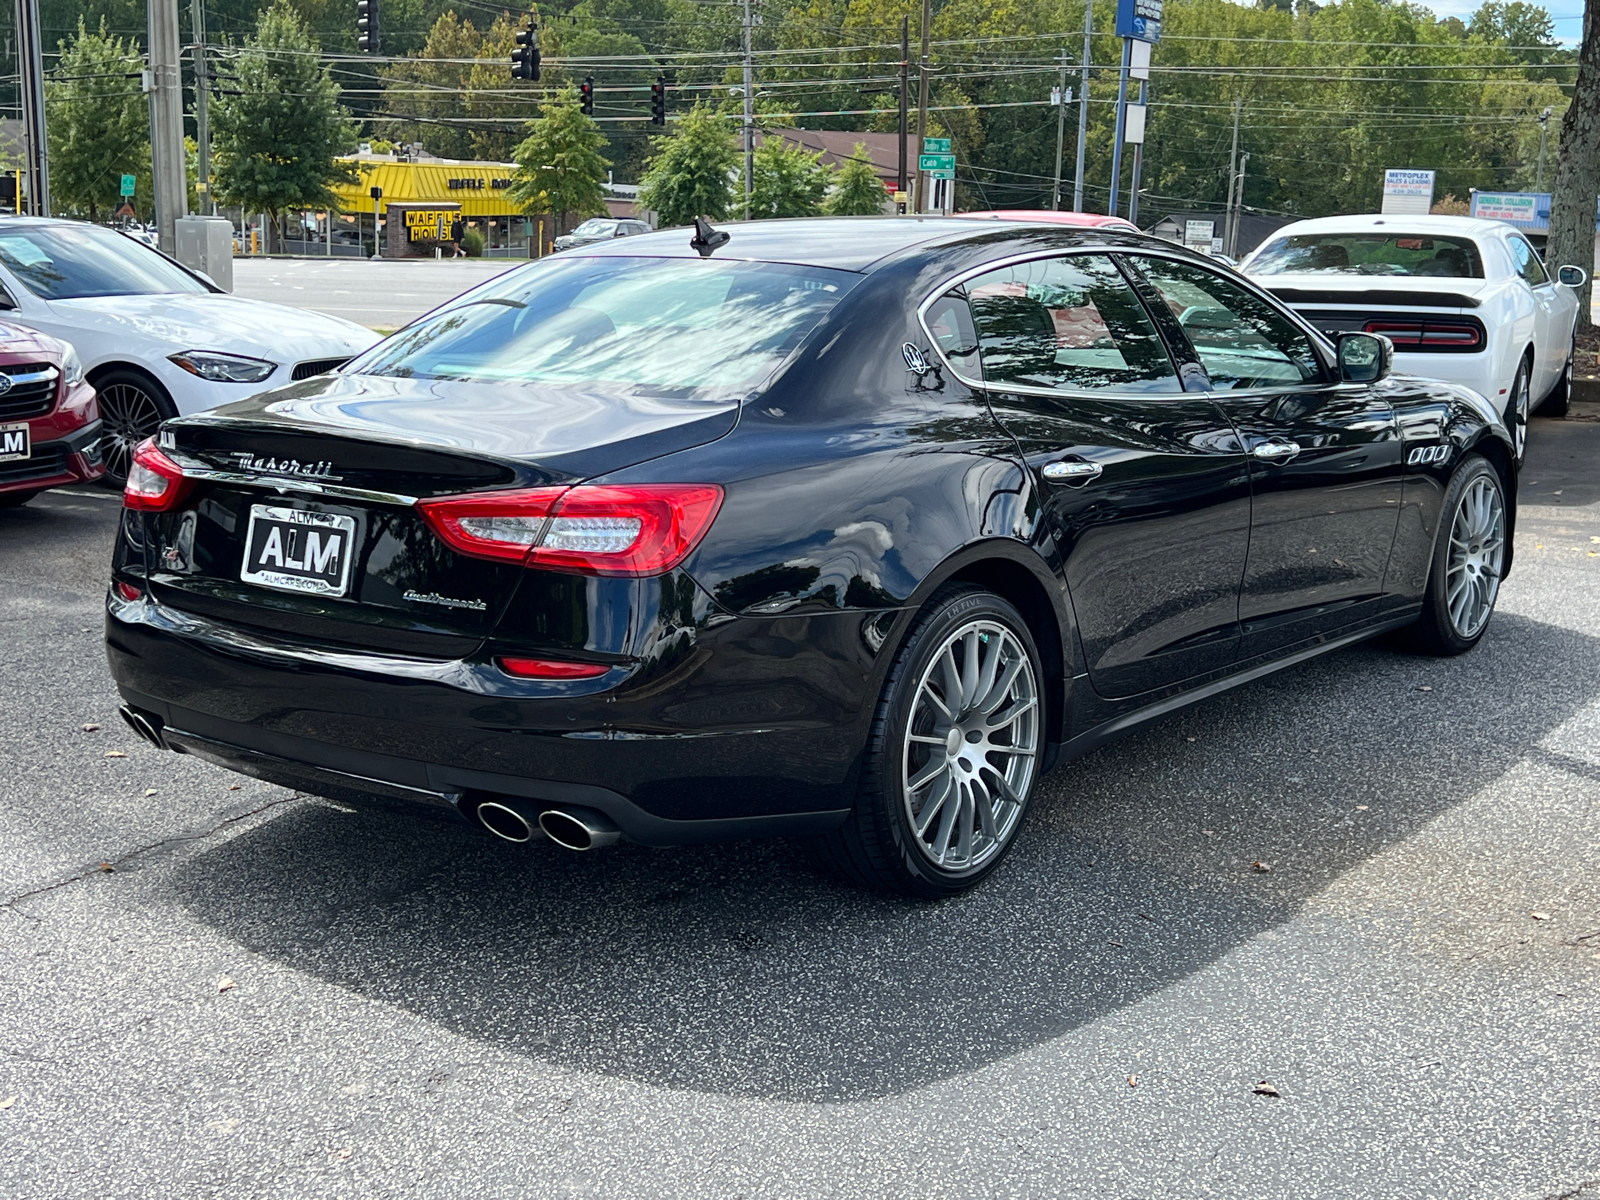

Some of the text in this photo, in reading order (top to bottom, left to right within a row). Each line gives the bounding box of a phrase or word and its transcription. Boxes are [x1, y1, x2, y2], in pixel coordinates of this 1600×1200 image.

[922, 158, 937, 167] Cobb
[449, 179, 512, 189] WAFFLE HOU
[1478, 196, 1533, 207] GENERAL COLLISION
[414, 228, 451, 239] HOUS
[230, 452, 343, 481] Maserati
[289, 510, 314, 525] ALM
[259, 526, 341, 576] ALM
[403, 589, 487, 610] Quattroporte
